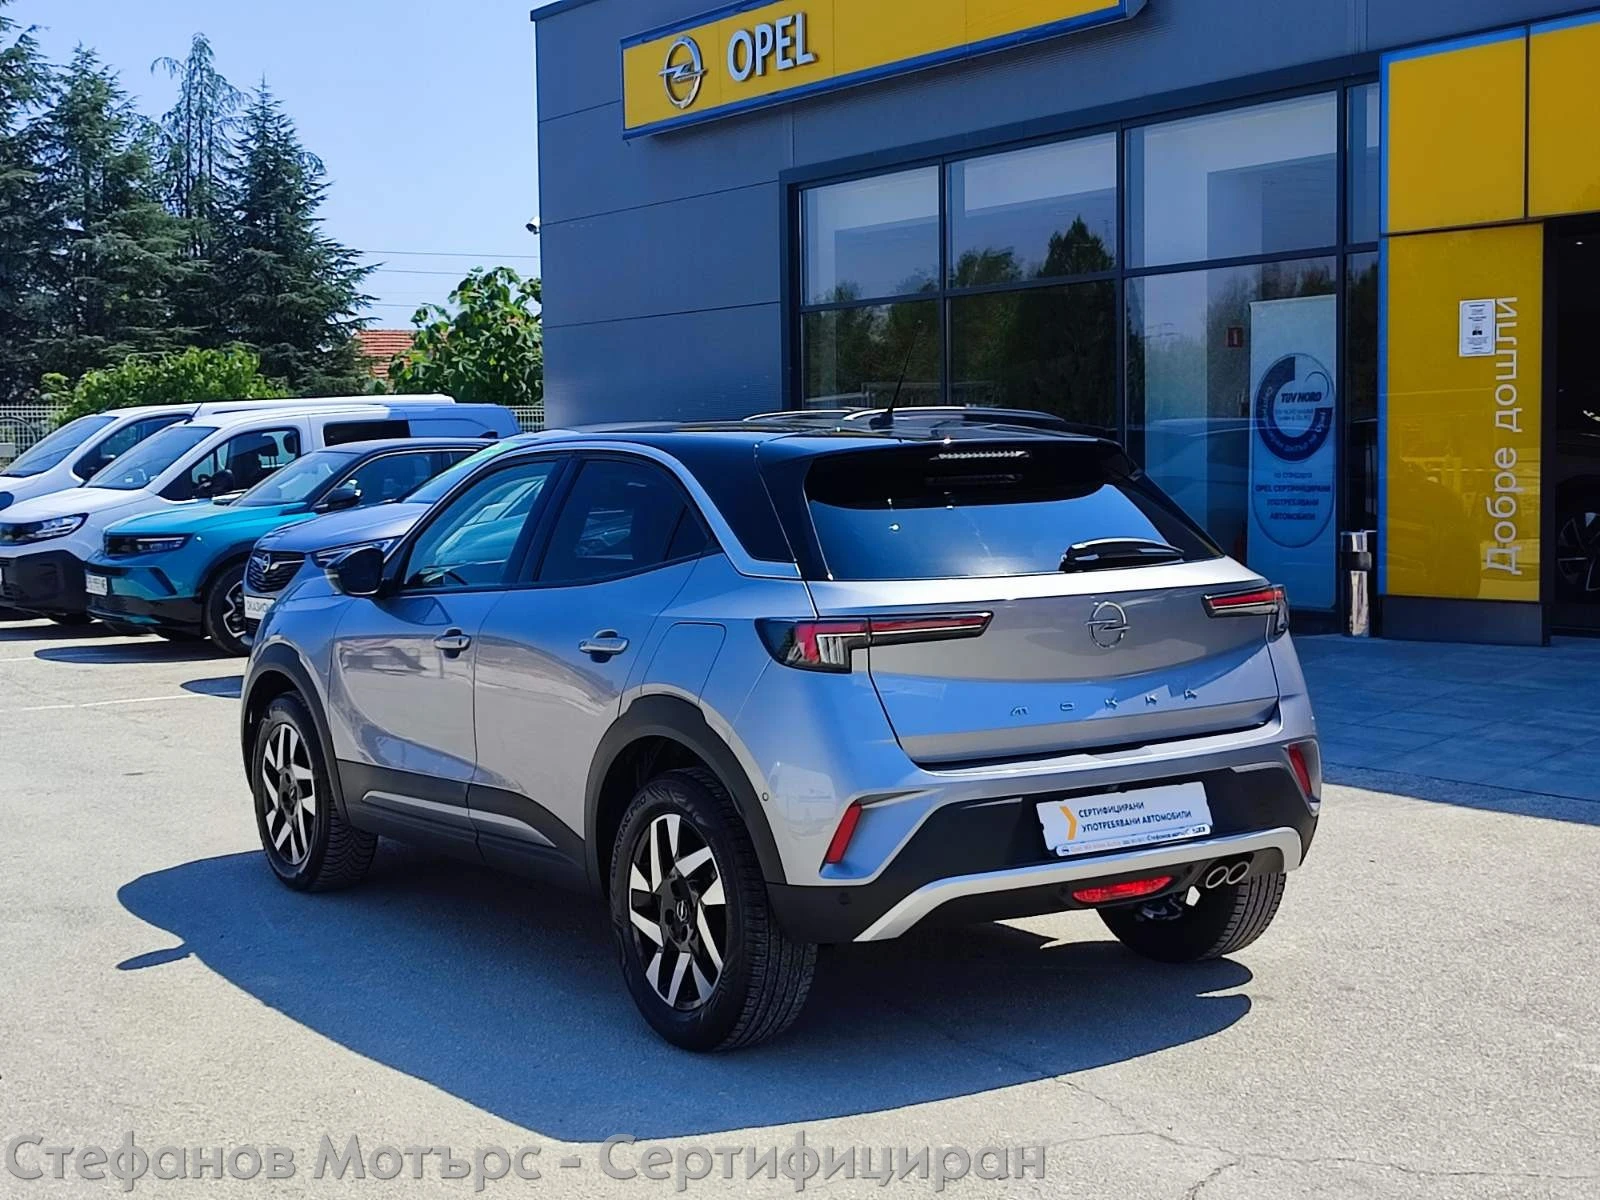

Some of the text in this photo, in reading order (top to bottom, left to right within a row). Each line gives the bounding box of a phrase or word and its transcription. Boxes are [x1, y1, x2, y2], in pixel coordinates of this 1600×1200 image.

[727, 12, 817, 82] OPEL
[1297, 391, 1322, 402] NORD
[1486, 296, 1522, 576] Добре дошли
[1010, 688, 1198, 716] MOKKA
[1078, 801, 1145, 818] СЕРТИФИЦИРАНИ
[1081, 810, 1192, 833] УПОТРЕБЯВАНИ АВТОМОБИЛИ
